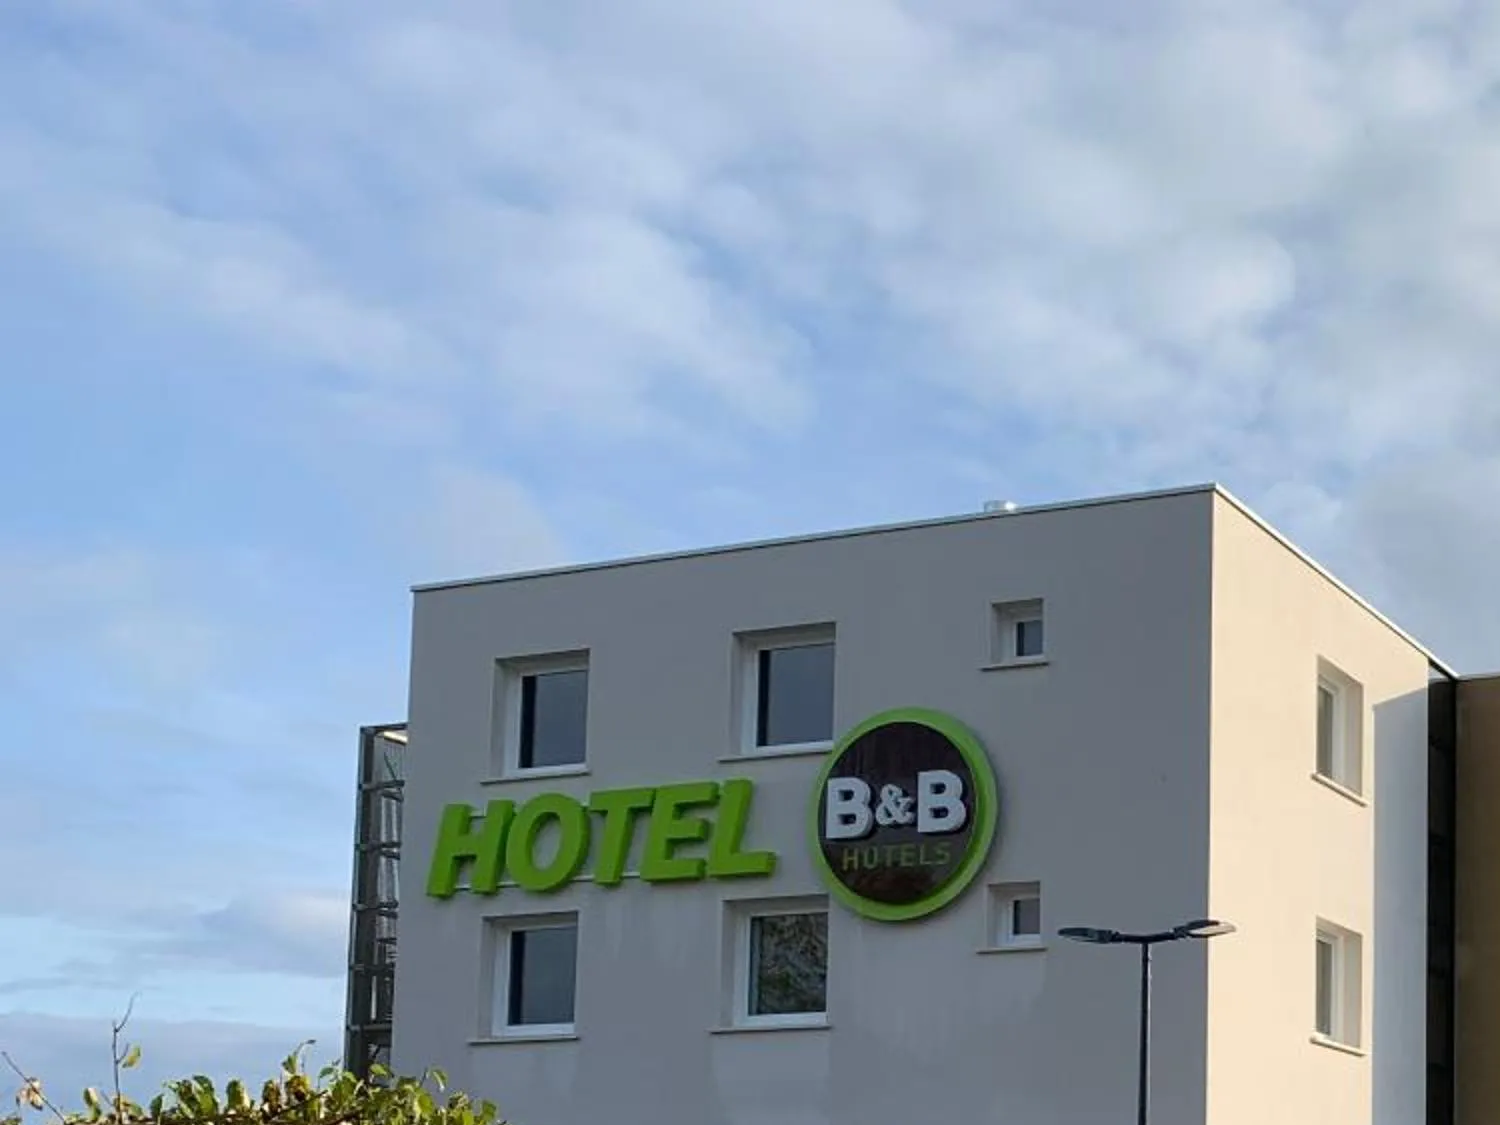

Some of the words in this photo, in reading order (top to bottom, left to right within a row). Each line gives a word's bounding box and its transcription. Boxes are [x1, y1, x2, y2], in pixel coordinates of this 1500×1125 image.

[426, 778, 777, 898] HOTEL
[826, 769, 966, 839] B&B
[841, 840, 951, 871] HOTELS
